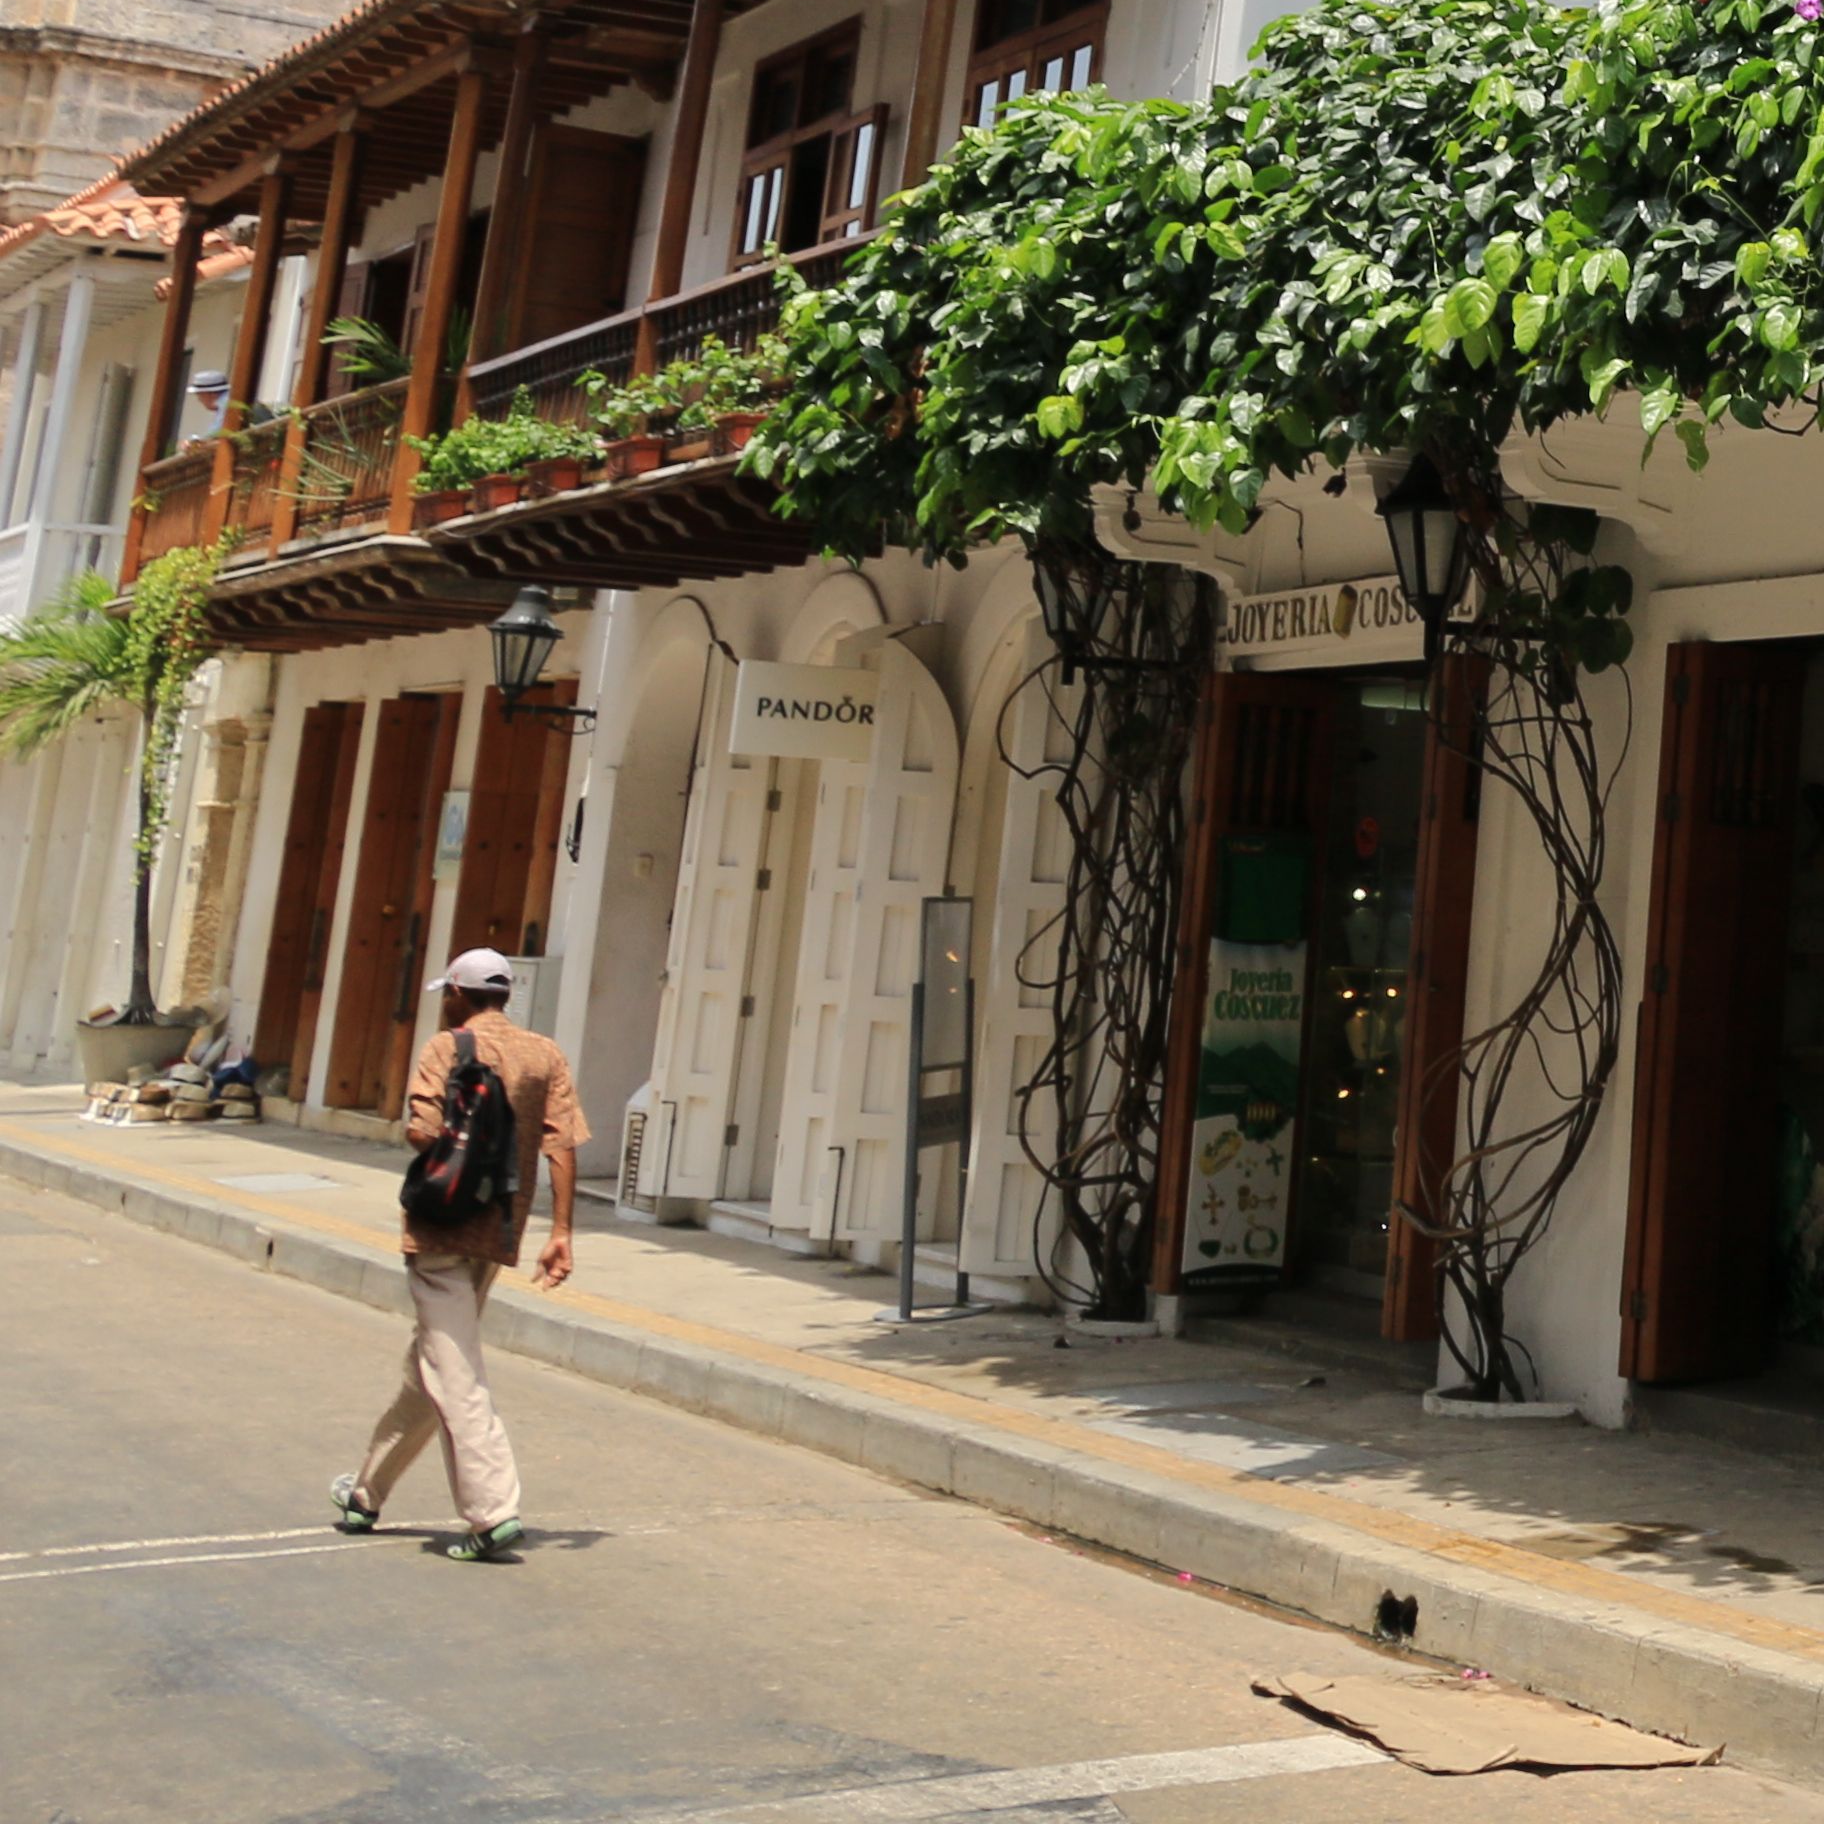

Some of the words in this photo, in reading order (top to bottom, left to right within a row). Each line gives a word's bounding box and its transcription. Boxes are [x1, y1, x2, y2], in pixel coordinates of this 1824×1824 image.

[1227, 593, 1332, 645] JOYERIA
[756, 696, 875, 725] PANDOR
[1214, 990, 1302, 1021] Coscuez
